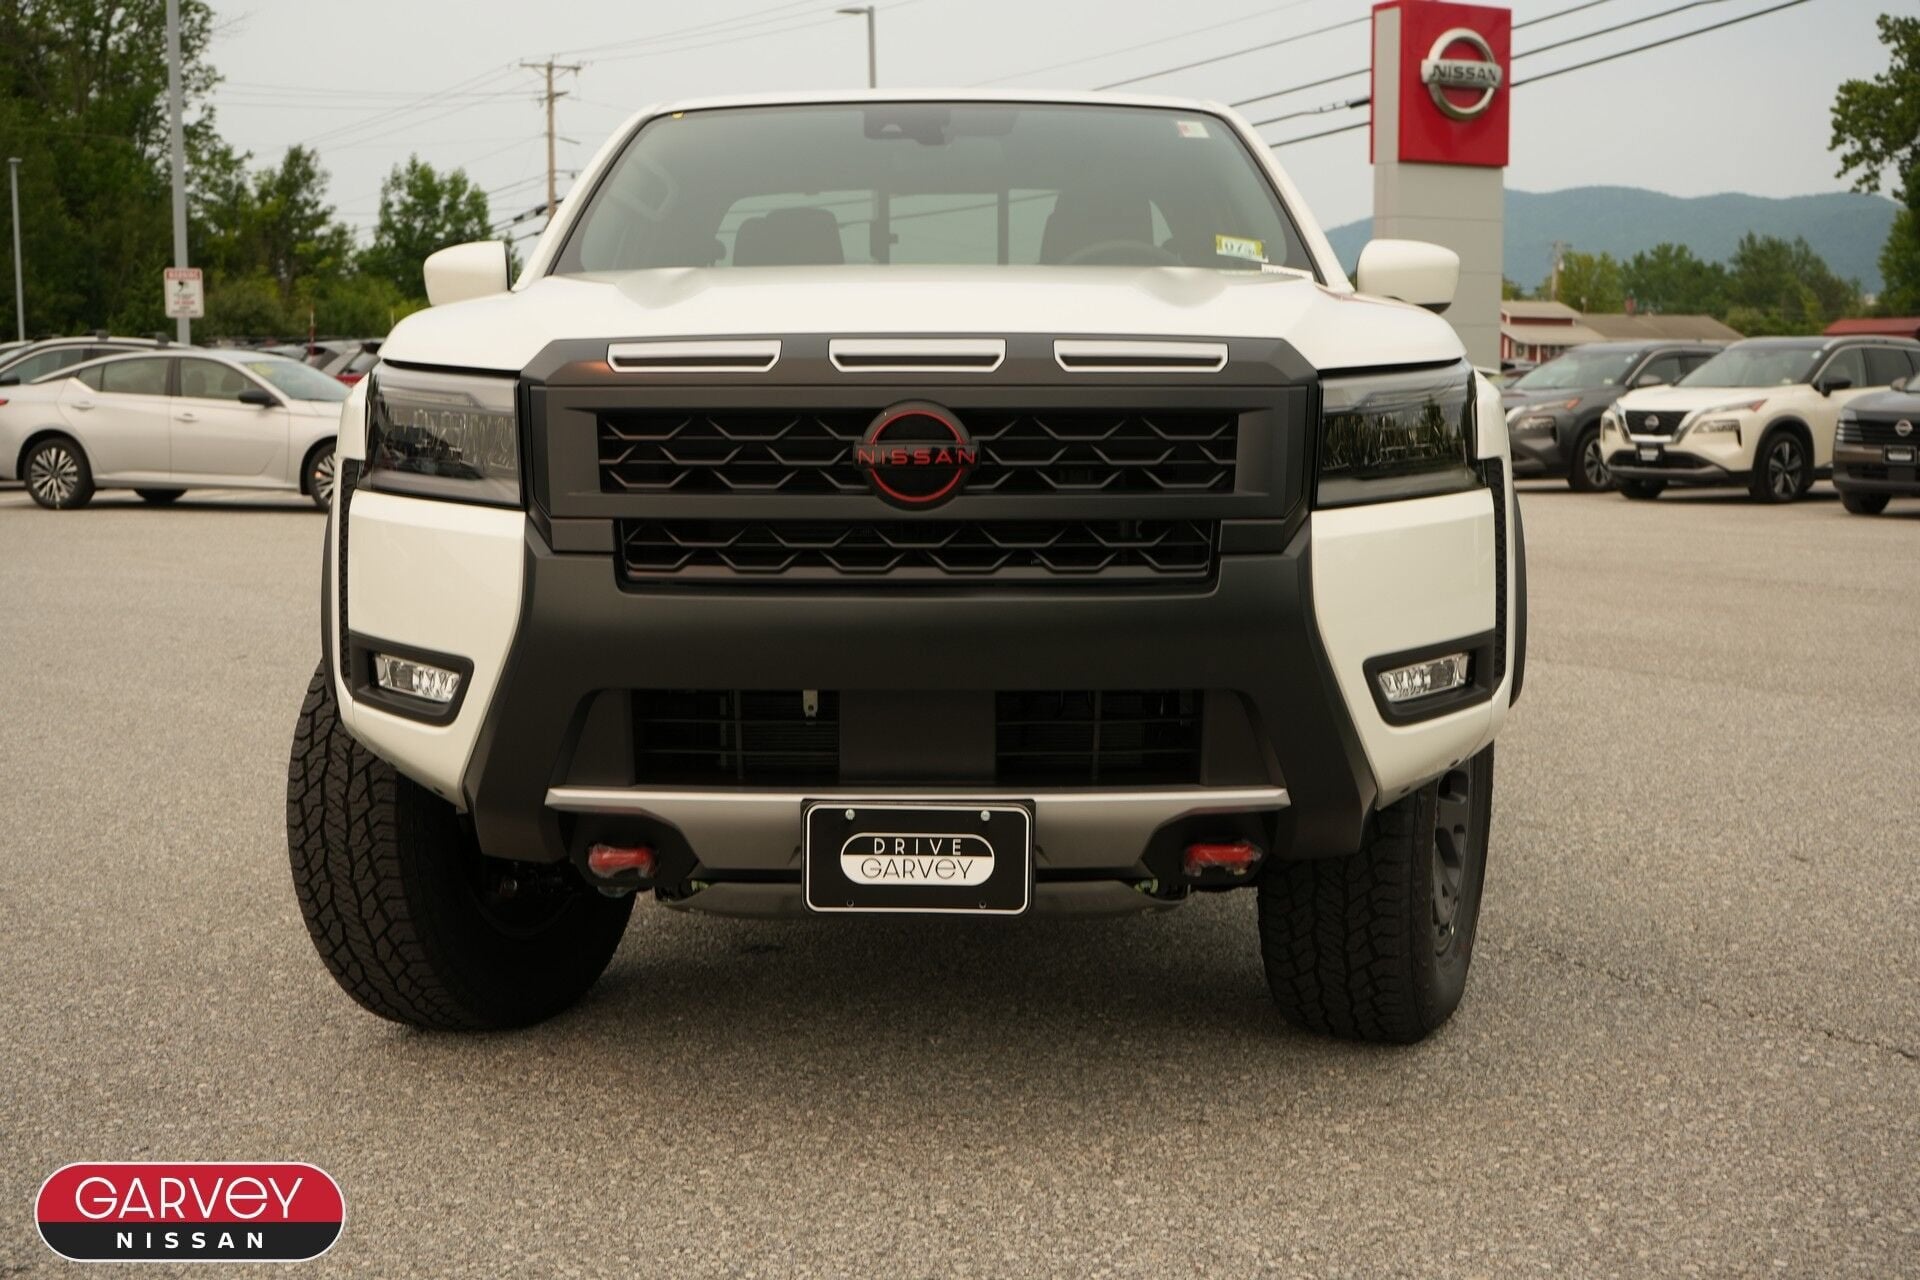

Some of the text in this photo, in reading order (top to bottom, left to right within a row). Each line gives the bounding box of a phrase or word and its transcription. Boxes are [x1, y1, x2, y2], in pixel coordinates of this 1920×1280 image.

[1432, 64, 1497, 81] NISSAN
[858, 448, 976, 465] NISSAN
[873, 837, 962, 856] DRIVE
